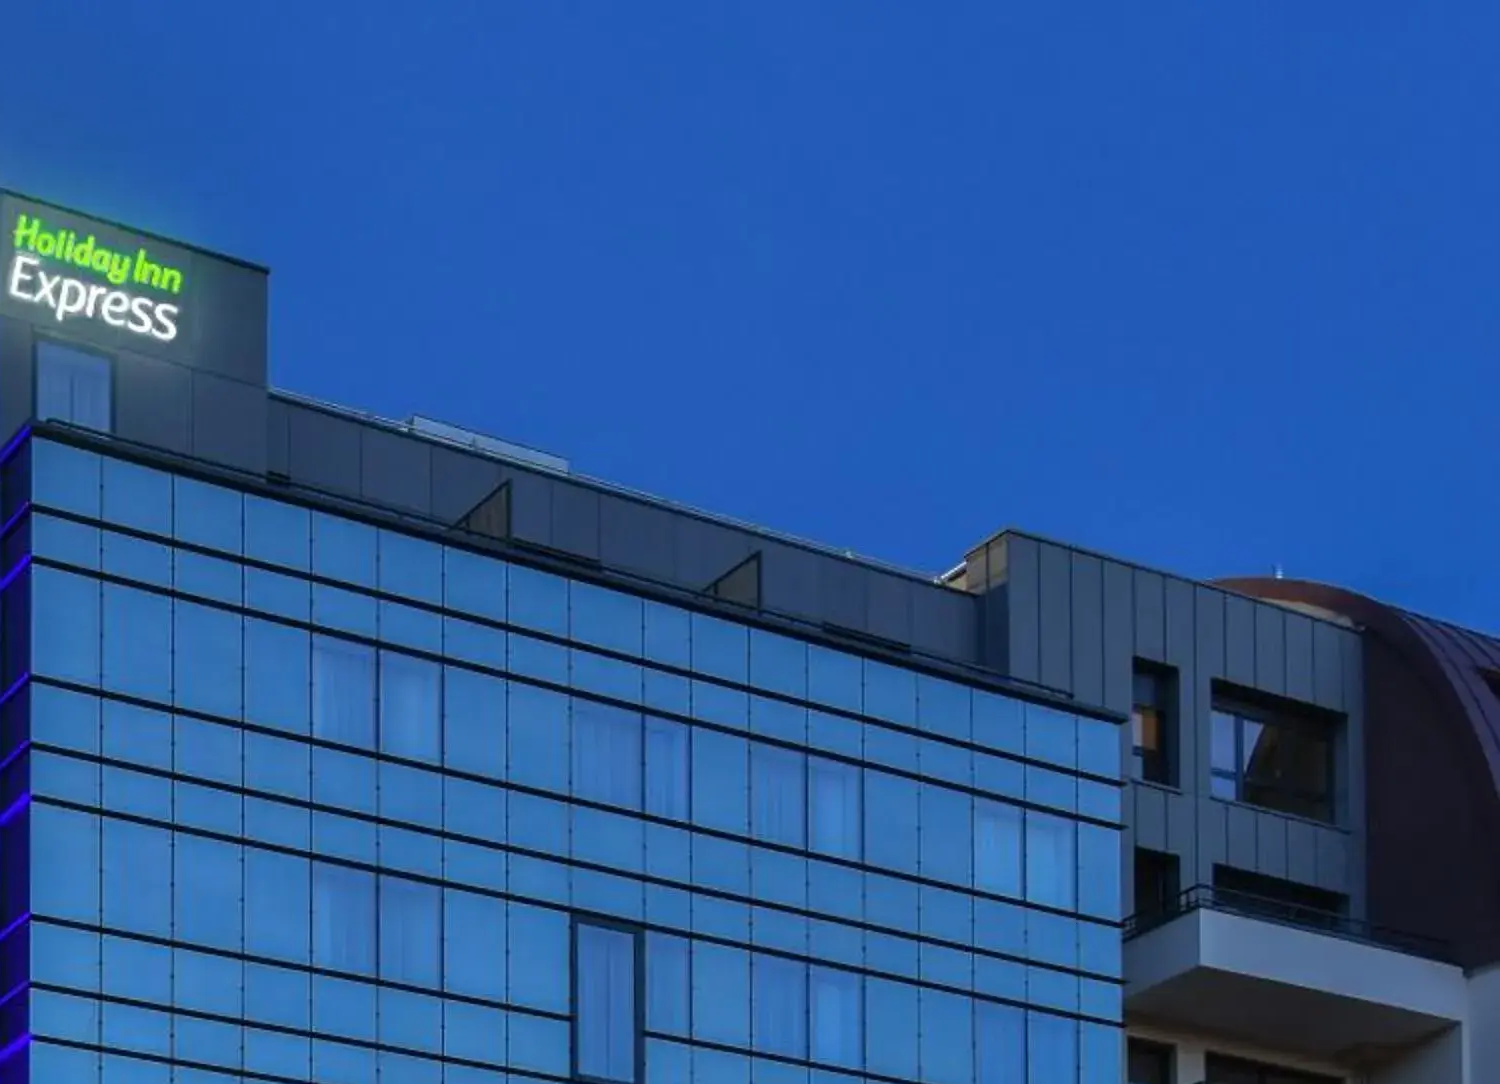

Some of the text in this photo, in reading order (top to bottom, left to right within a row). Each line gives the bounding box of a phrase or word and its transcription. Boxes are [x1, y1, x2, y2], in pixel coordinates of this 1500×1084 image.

[13, 214, 183, 295] Holiday Inn
[8, 255, 180, 342] Express
